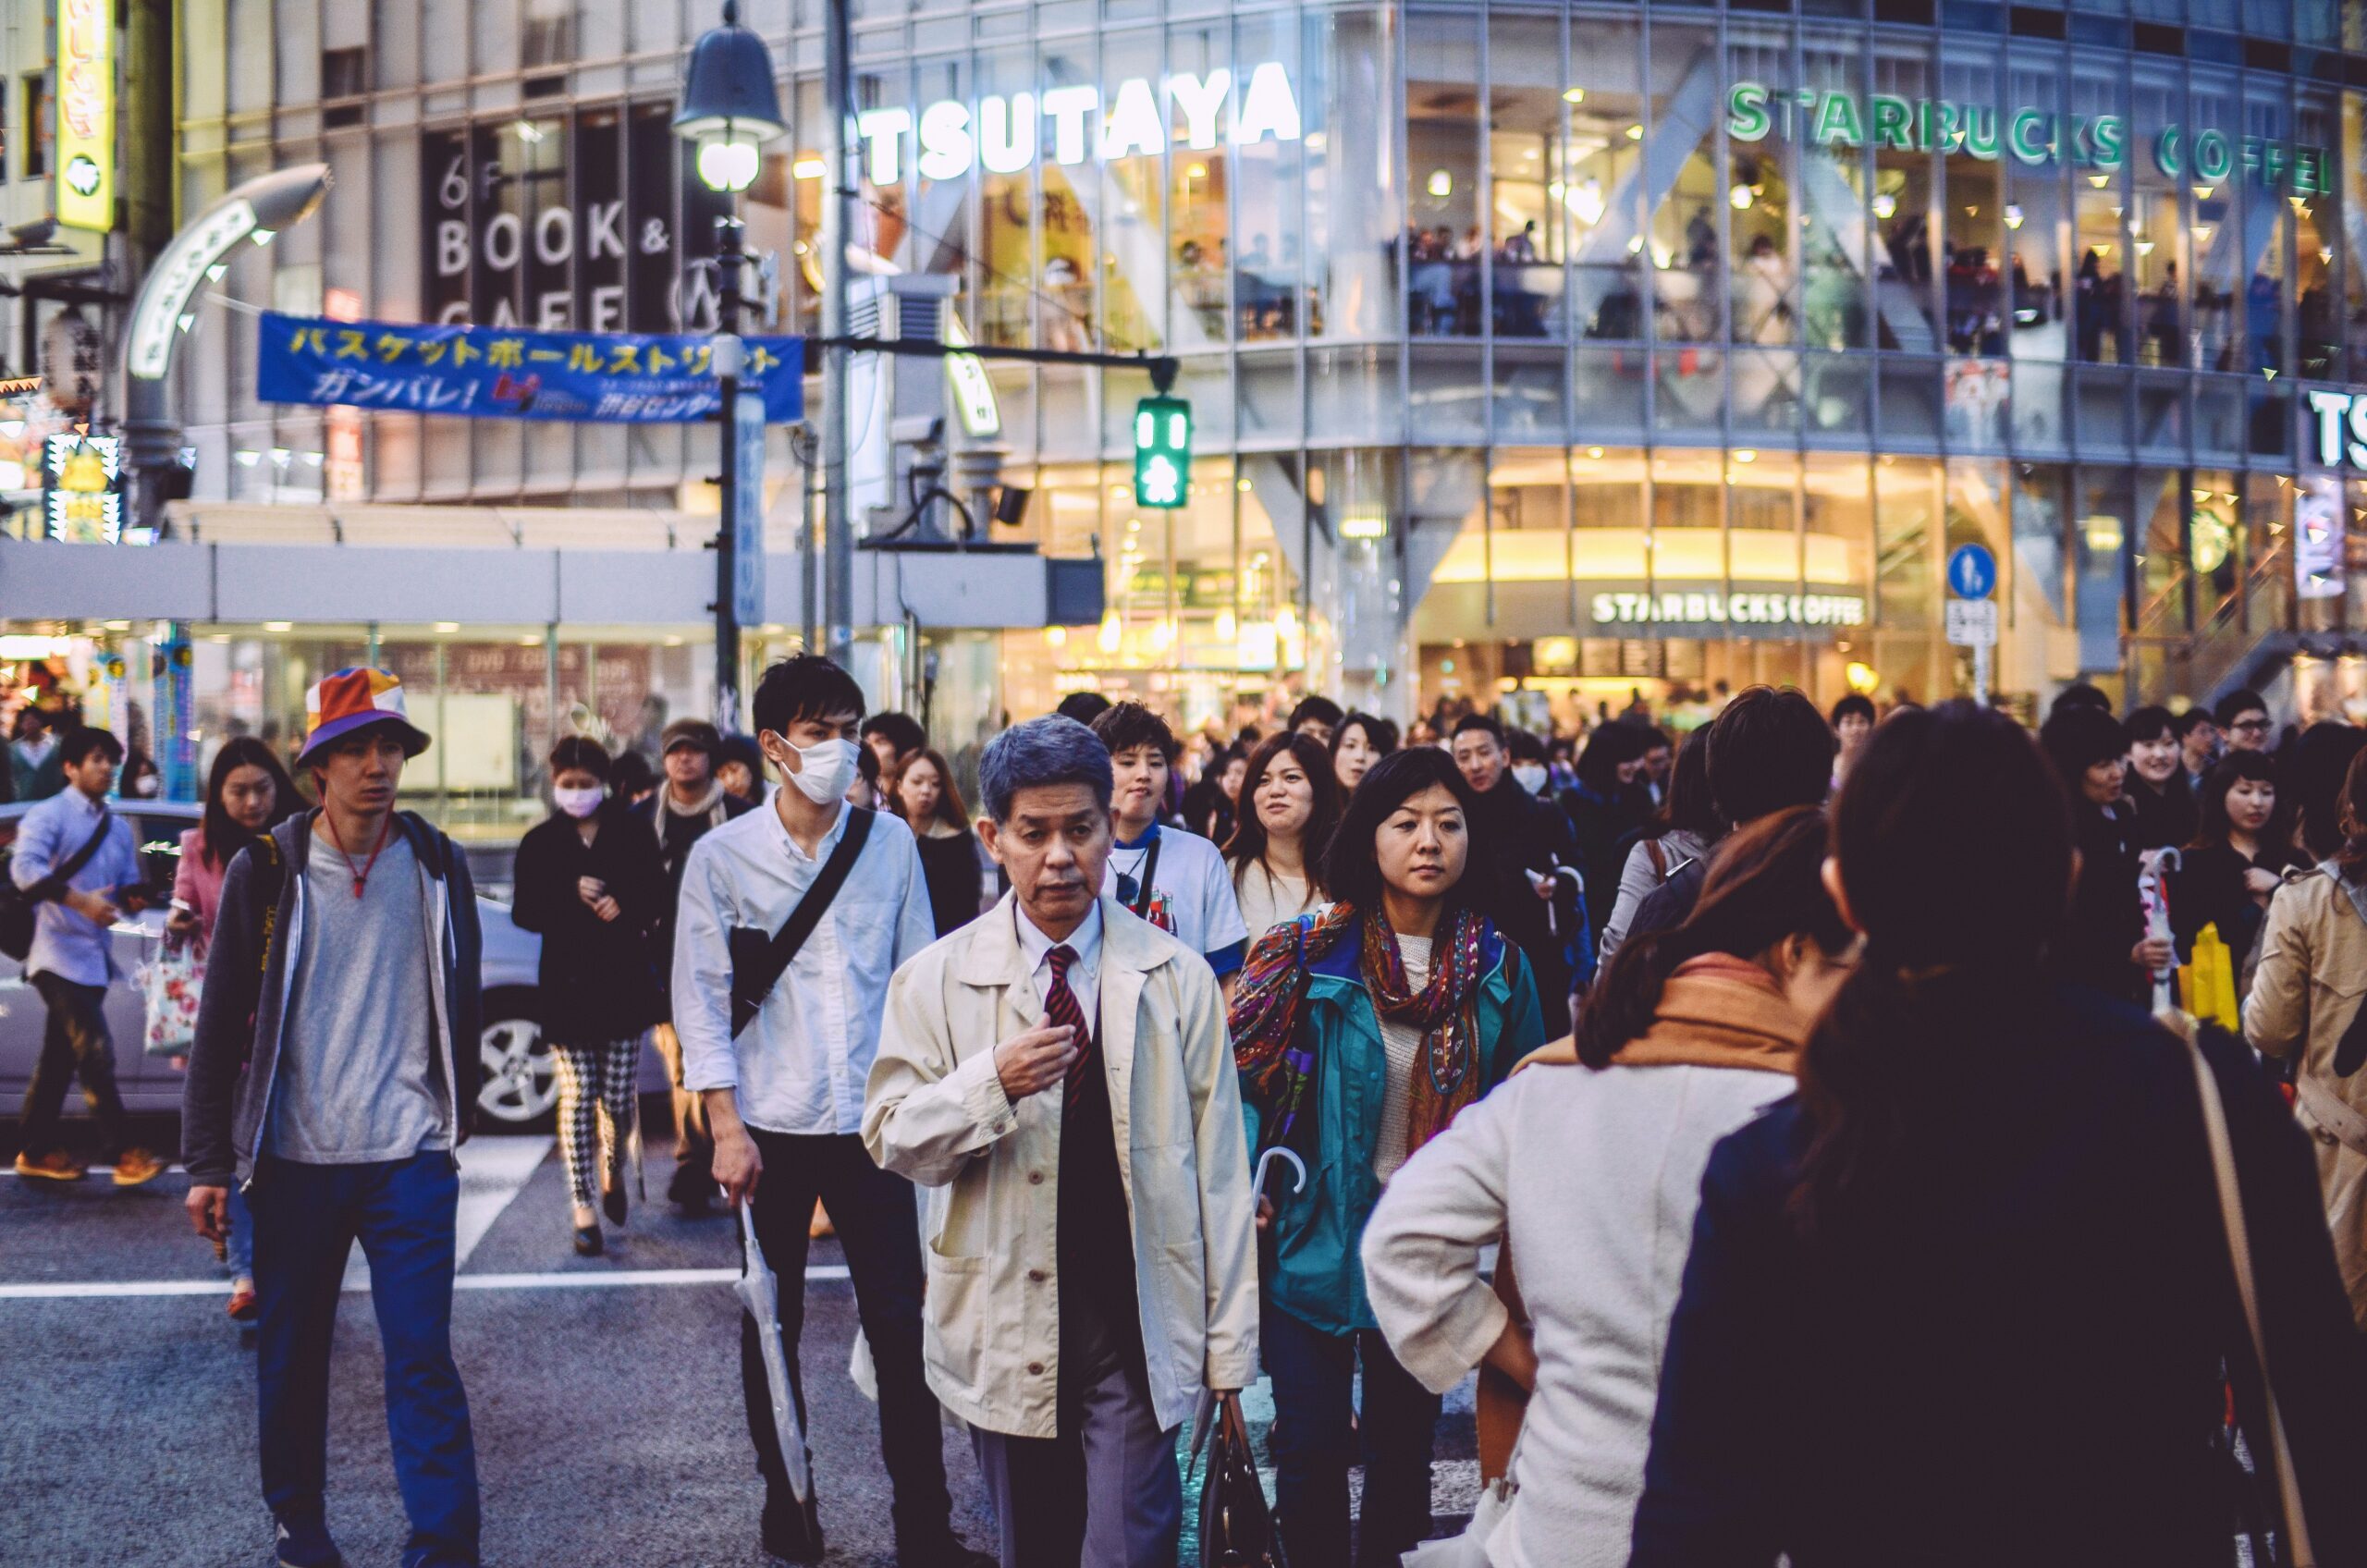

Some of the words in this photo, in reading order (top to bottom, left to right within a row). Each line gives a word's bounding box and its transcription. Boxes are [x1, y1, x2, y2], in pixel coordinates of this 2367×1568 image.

[859, 61, 1301, 187] TSUTAYA
[1728, 81, 2123, 170] STARBUCKS
[437, 200, 627, 276] BOOK
[640, 216, 670, 255] &
[289, 327, 781, 374] バスケットボールストリト
[1591, 593, 1787, 623] STARBUCKS
